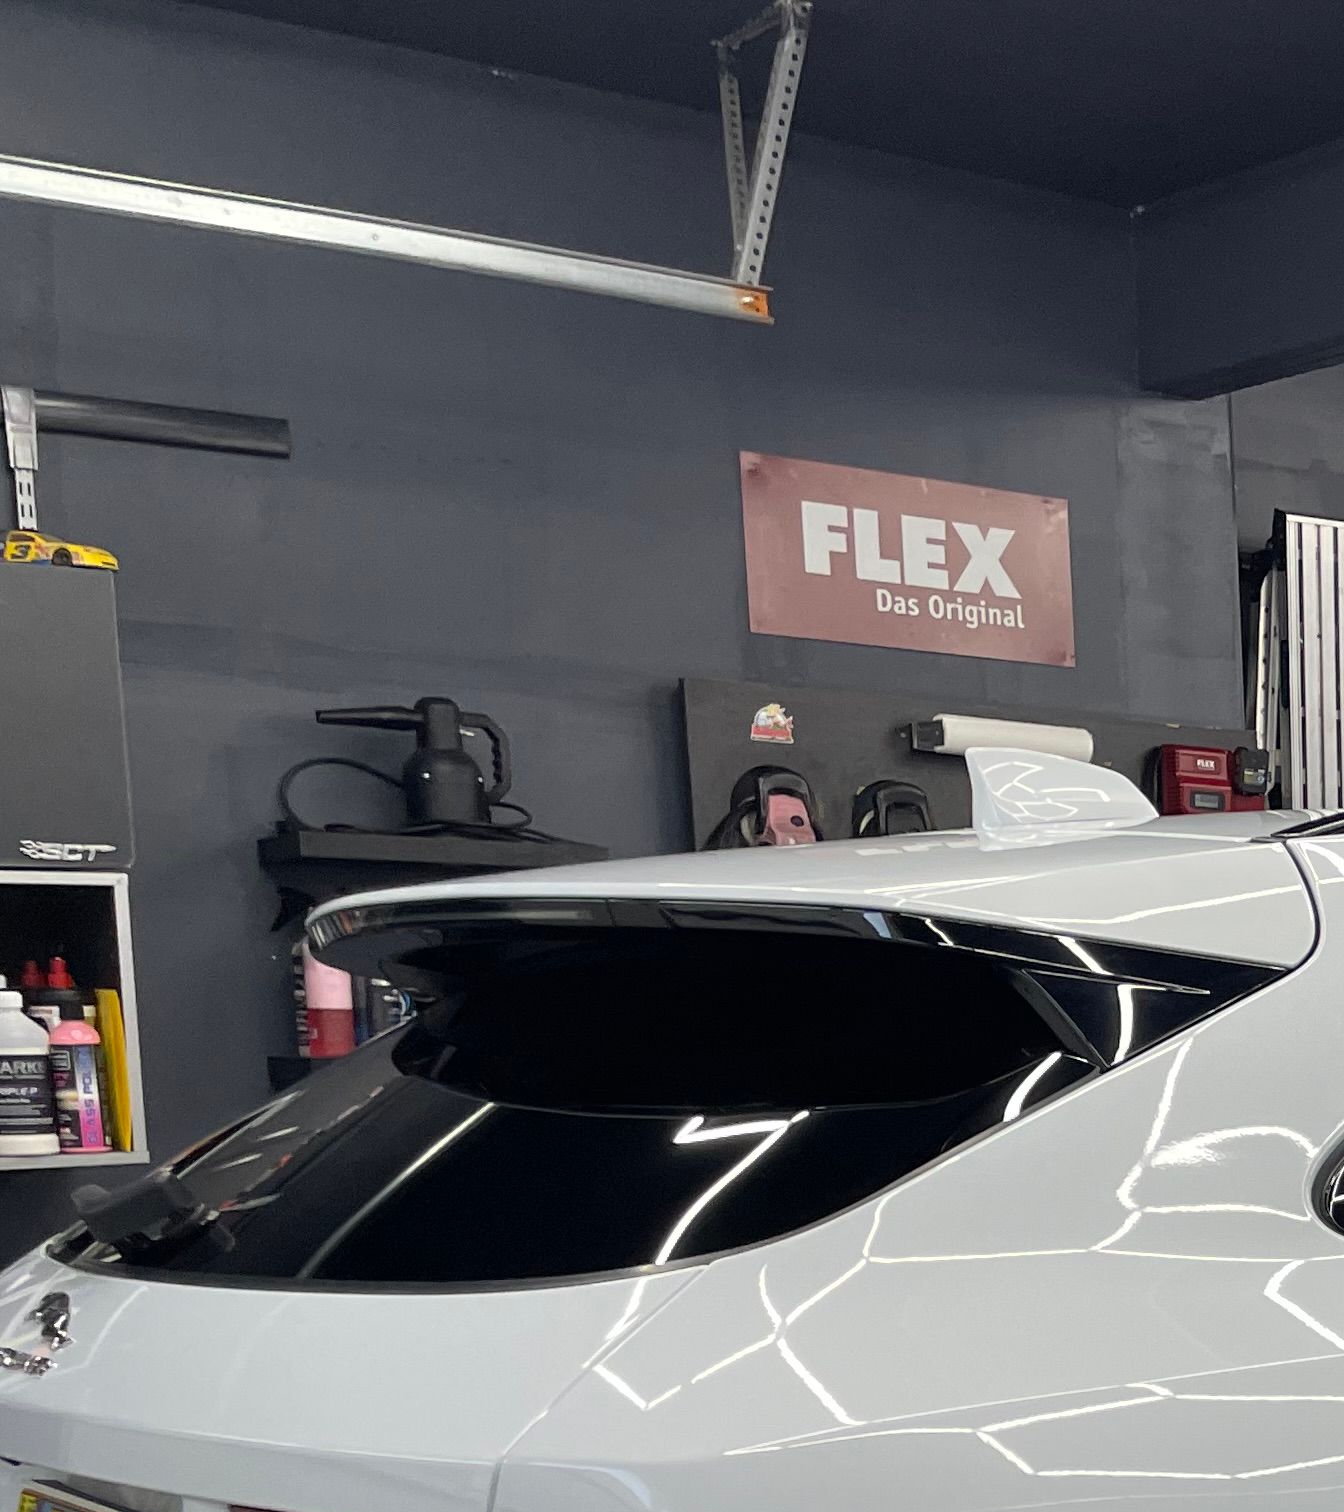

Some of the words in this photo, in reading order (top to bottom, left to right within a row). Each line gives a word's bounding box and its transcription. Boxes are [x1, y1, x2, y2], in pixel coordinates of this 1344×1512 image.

[801, 500, 1023, 600] FLEX
[876, 588, 920, 617] Das
[928, 594, 1026, 630] Original
